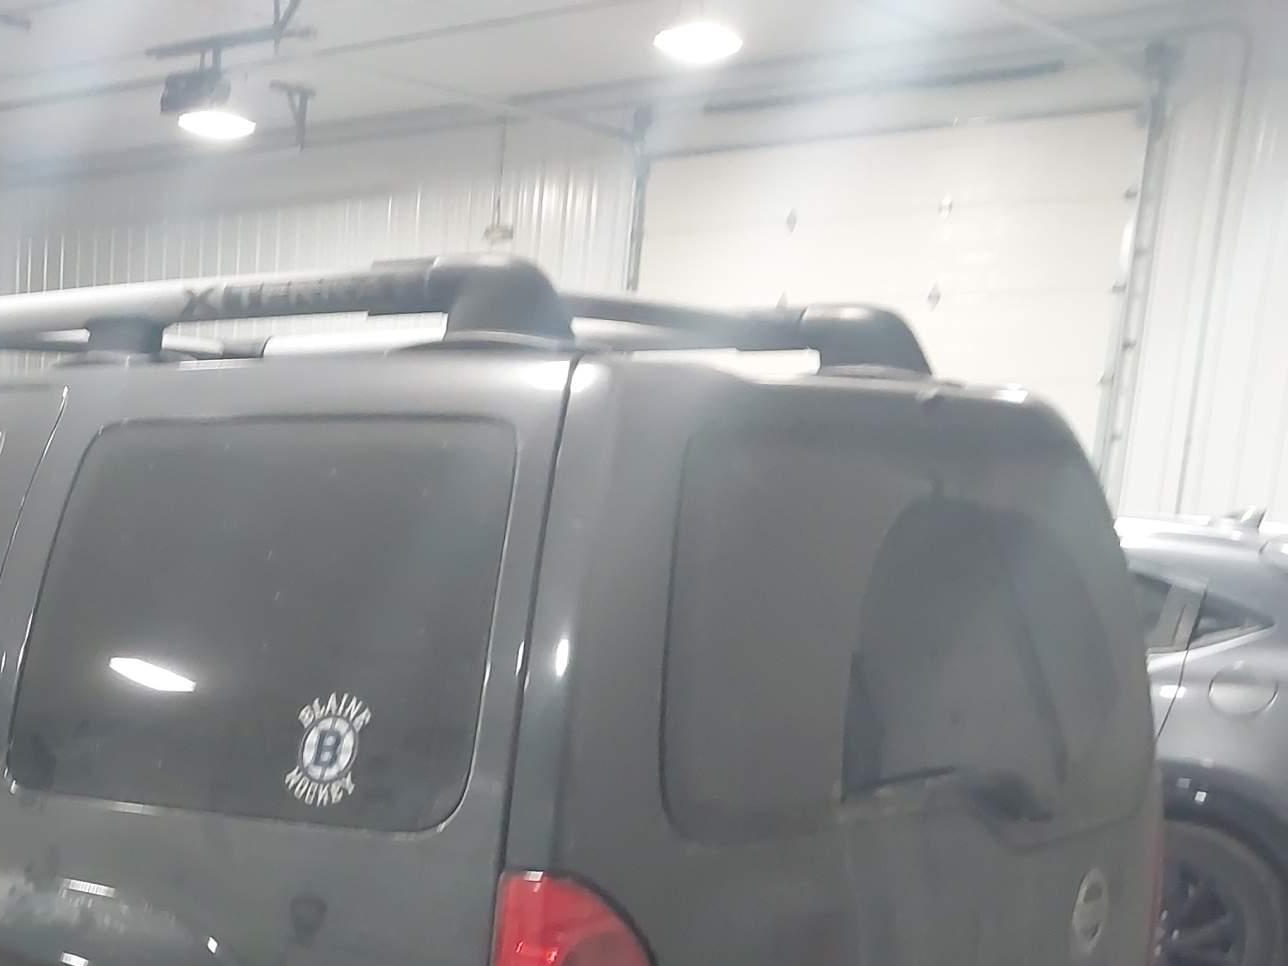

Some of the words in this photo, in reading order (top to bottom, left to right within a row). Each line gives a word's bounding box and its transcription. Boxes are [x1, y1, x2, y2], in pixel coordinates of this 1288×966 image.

[298, 691, 372, 733] BLAINE
[312, 729, 342, 768] B
[285, 765, 356, 807] HOCKEY
